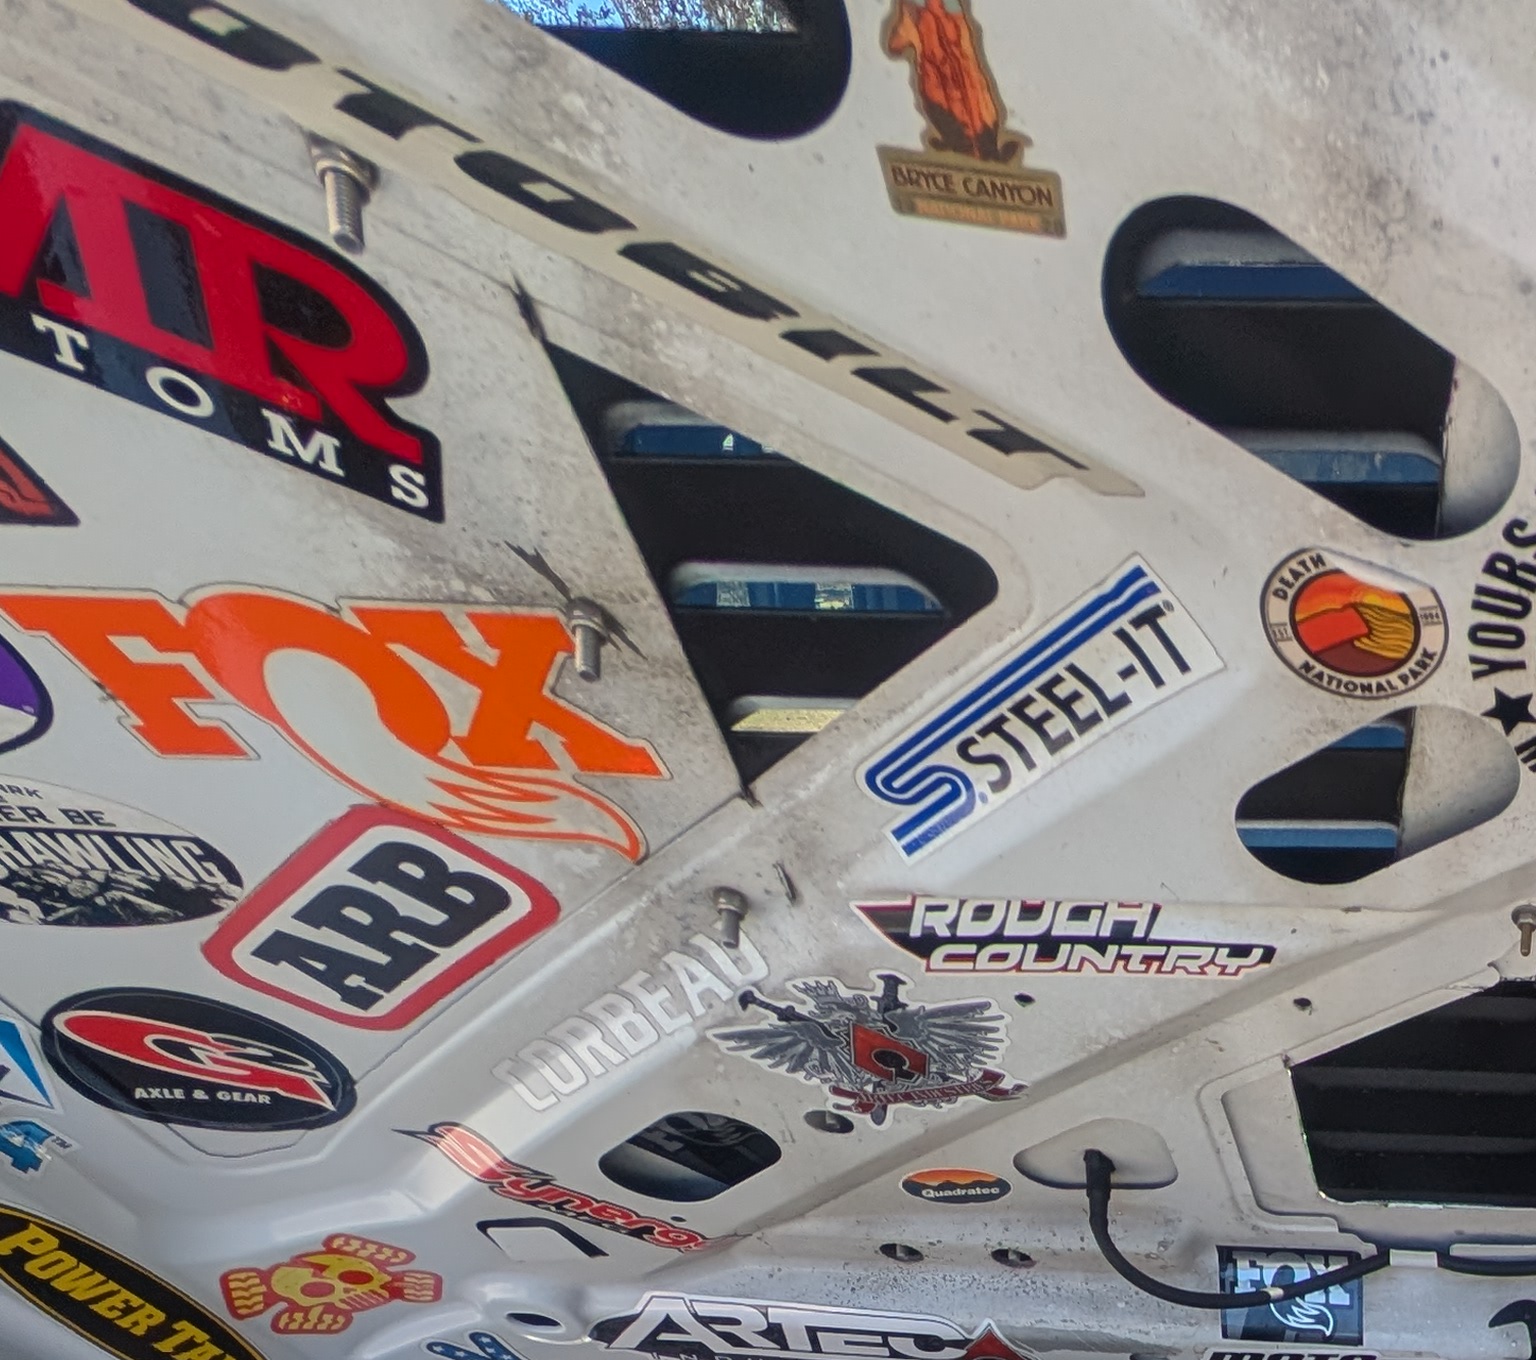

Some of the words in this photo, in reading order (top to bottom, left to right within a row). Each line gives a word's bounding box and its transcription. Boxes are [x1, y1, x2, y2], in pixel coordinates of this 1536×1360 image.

[890, 163, 955, 195] BRYCE
[962, 177, 1054, 208] CANYON
[1272, 553, 1327, 601] DEATH
[1299, 660, 1399, 694] NATIONAL
[1397, 647, 1438, 686] PARK
[956, 604, 1192, 795] STEEL-IT
[0, 592, 666, 866] FOX
[58, 808, 117, 828] BE
[250, 841, 513, 1012] ARB
[908, 898, 1160, 940] ROUGH
[926, 943, 1264, 976] COUNTRY
[134, 1087, 186, 1100] AXLE
[192, 1087, 210, 1100] &
[217, 1090, 272, 1104] GEAR
[920, 1184, 1001, 1199] Quadratec
[0, 1223, 168, 1338] POWER
[605, 1296, 968, 1360] ARTEC
